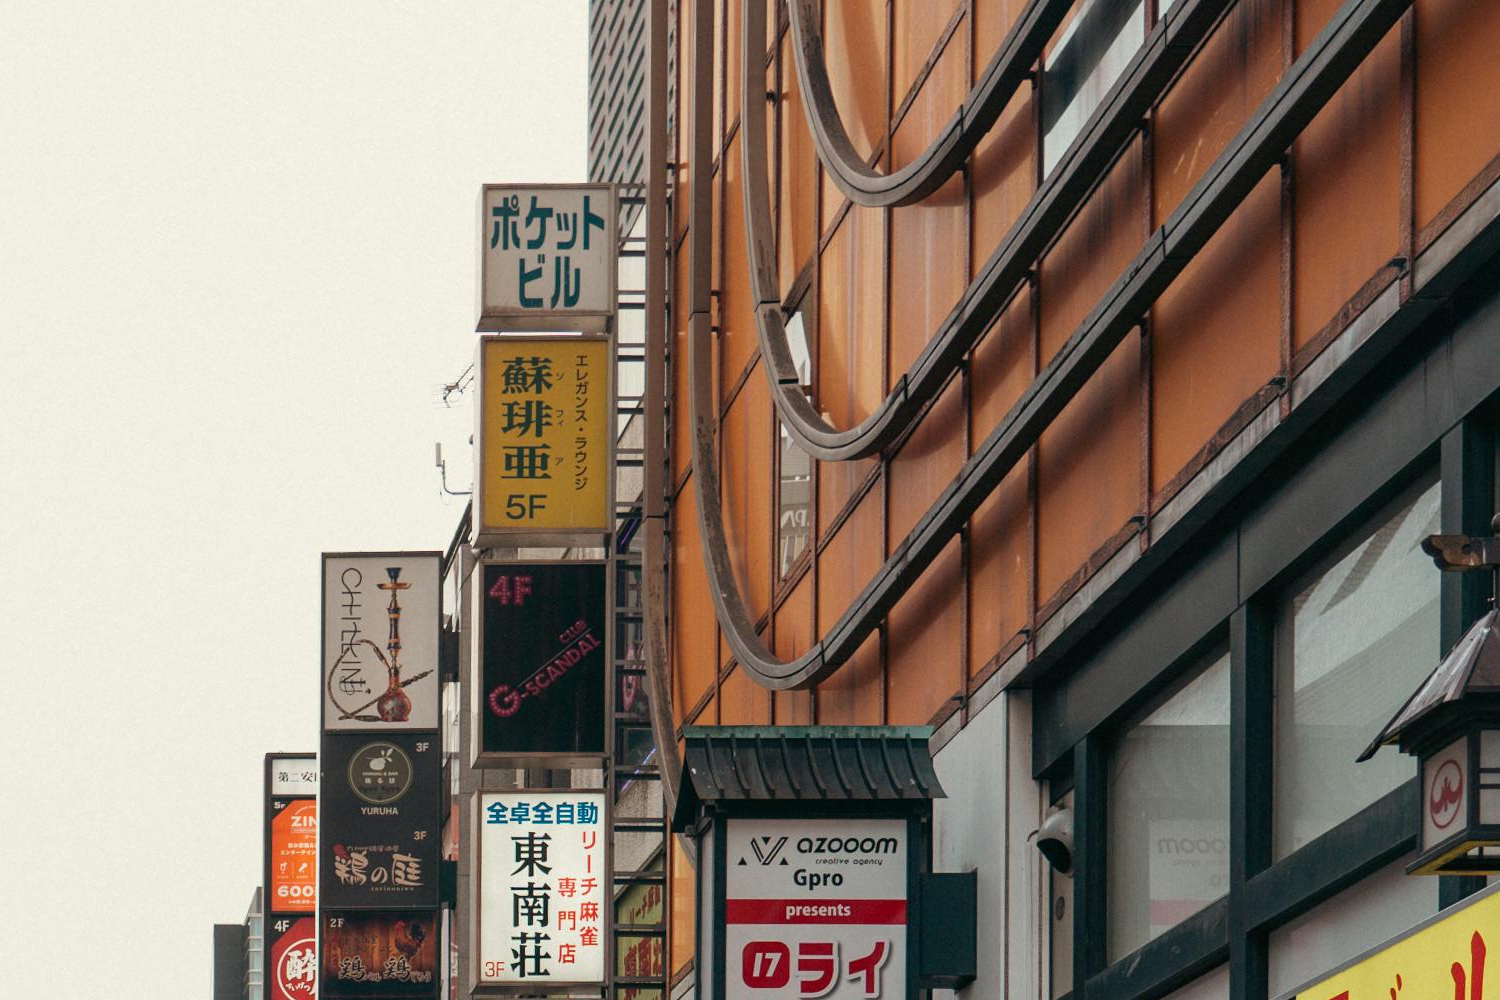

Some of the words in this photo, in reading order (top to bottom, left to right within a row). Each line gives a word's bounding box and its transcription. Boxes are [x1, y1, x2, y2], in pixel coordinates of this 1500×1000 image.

[491, 194, 605, 250] ポケット
[518, 253, 581, 309] ビル
[574, 354, 589, 491] エレガンス・ラウンジ
[506, 495, 547, 520] 5F
[488, 575, 533, 606] 4F
[558, 618, 589, 645] CLUB
[488, 632, 601, 718] G-SCANDAL
[416, 743, 429, 752] 3F
[361, 807, 399, 815] YURUHA
[486, 801, 599, 825] 全卓全自動
[414, 831, 427, 840] 3F
[796, 837, 898, 854] azooom
[853, 858, 883, 867] agency
[579, 831, 599, 947] リーチ麻雀
[793, 868, 844, 890] Gpro
[510, 832, 553, 978] 東南荘
[785, 903, 851, 920] presents
[274, 919, 290, 933] 4F
[330, 918, 345, 928] 2F
[557, 877, 577, 964] 専門店
[484, 961, 504, 978] 3F
